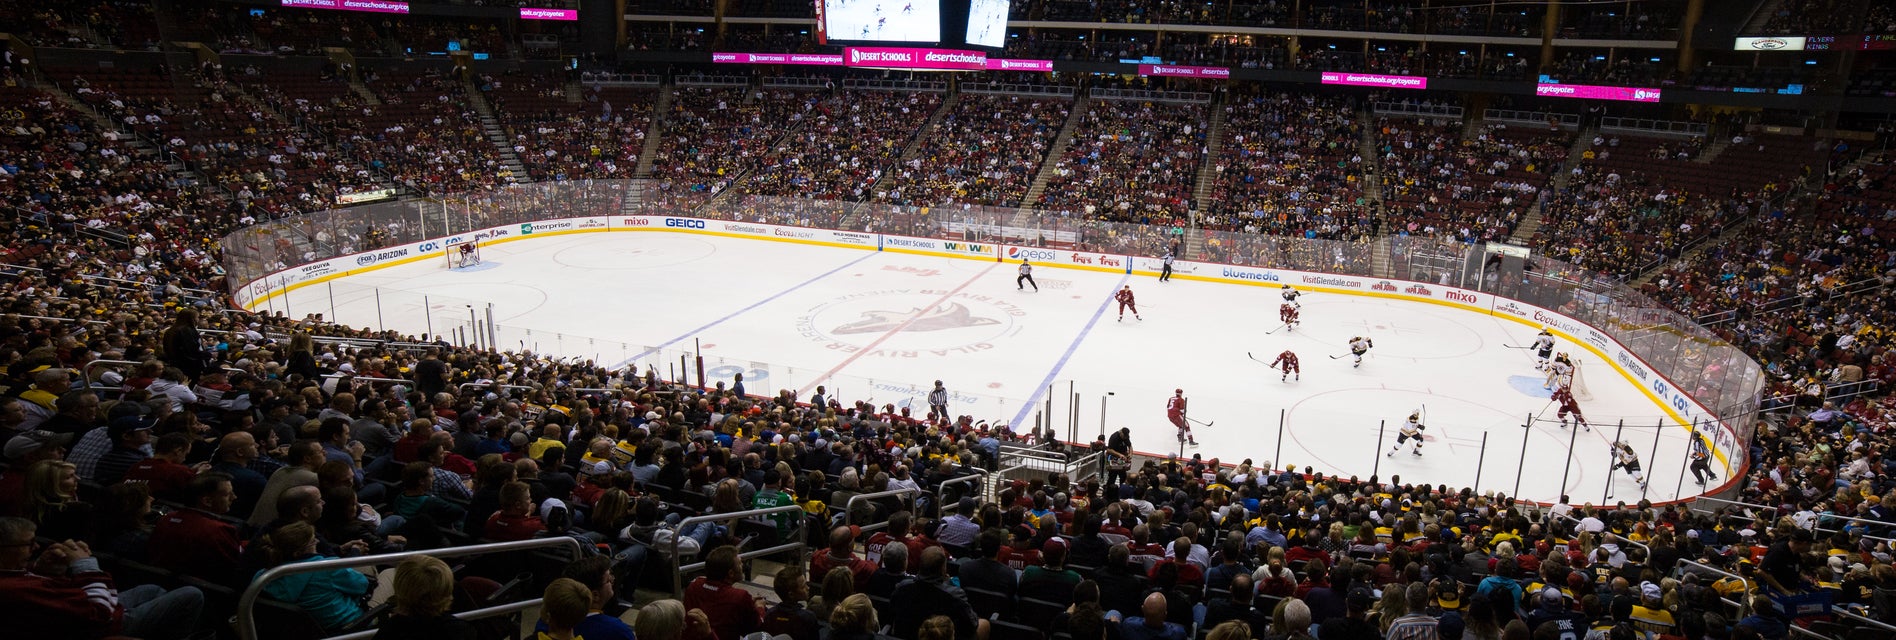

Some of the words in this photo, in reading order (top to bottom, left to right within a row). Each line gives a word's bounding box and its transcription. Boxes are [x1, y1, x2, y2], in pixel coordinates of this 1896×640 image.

[860, 52, 881, 61] DESERT
[881, 51, 911, 62] SCHOOLS
[1346, 75, 1421, 87] desertschools.org/coyotes
[666, 218, 705, 229] GEICO
[724, 223, 767, 235] VisitGlendale.com
[774, 226, 794, 238] Coors
[794, 231, 814, 239] LIGHT
[419, 241, 439, 253] COX
[893, 238, 912, 246] DESERT
[912, 240, 935, 249] SCHOOLS
[944, 242, 967, 251] WM
[969, 244, 992, 253] WM
[377, 248, 408, 262] ARIZONA
[1020, 249, 1056, 261] pepsi
[1071, 252, 1092, 265] fry's
[1099, 255, 1120, 267] fry's
[1222, 267, 1279, 282] bluemedia
[1302, 274, 1361, 288] VisitGlendale.com
[1371, 283, 1383, 291] PAPA
[1405, 286, 1417, 295] PAPA
[1533, 310, 1558, 327] Coors
[1557, 321, 1580, 334] LIGHT
[825, 341, 919, 359] RIVER
[929, 342, 995, 358] GILA
[1628, 360, 1648, 381] ARIZONA
[1653, 379, 1668, 400] COX
[1673, 394, 1689, 417] COX
[1555, 619, 1575, 631] ANE
